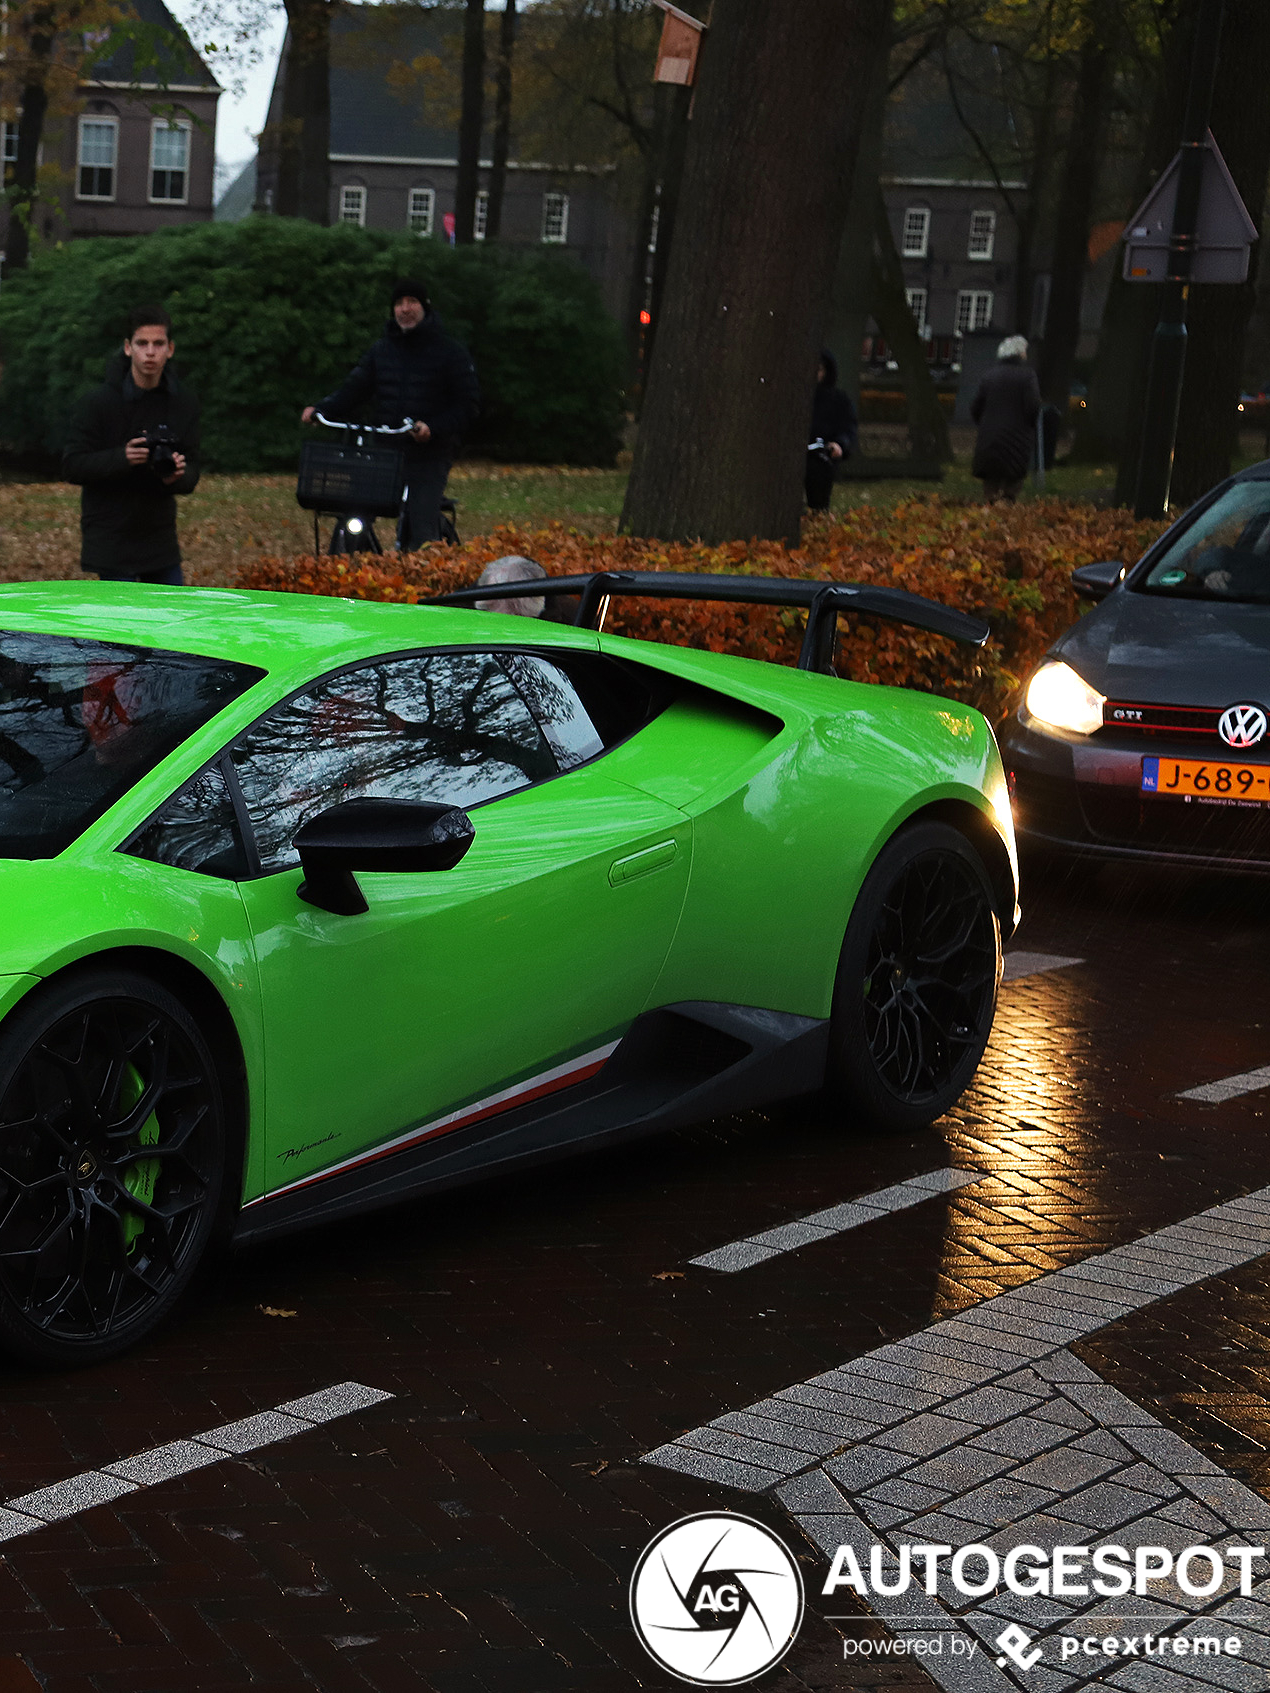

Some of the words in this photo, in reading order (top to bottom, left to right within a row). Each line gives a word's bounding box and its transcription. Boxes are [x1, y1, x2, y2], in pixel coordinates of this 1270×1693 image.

[1113, 709, 1143, 721] GTI
[1144, 777, 1156, 787] NL
[1166, 765, 1270, 796] J-689-
